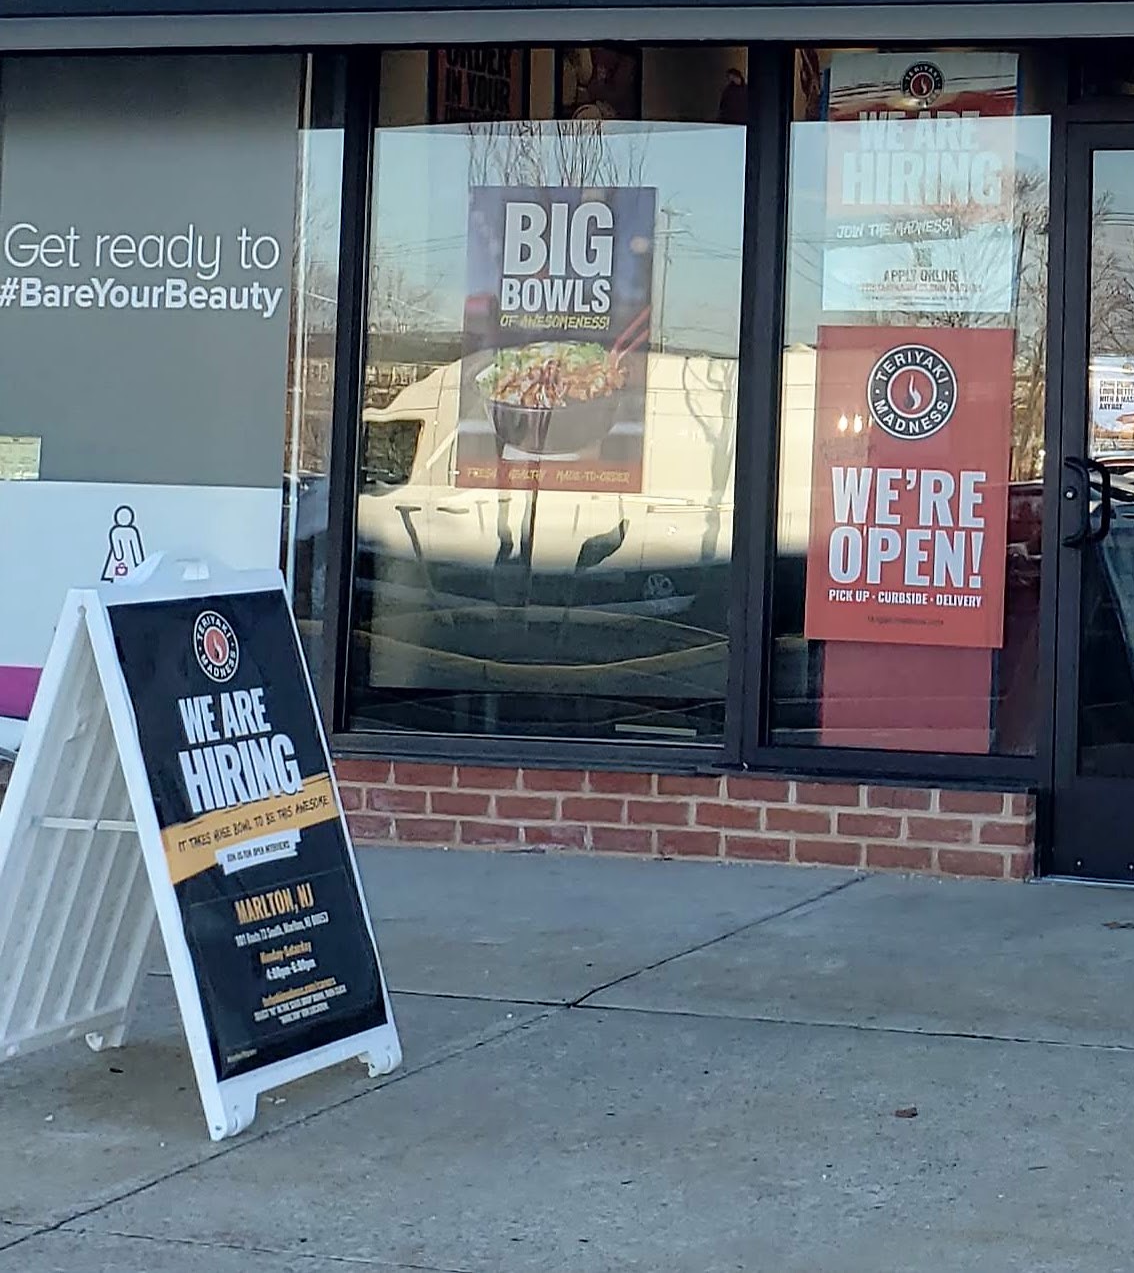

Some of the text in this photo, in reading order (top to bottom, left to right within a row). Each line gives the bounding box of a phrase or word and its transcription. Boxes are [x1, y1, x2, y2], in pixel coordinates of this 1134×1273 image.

[859, 110, 980, 150] WE ARE
[842, 150, 1002, 206] HIRING
[4, 222, 281, 280] Get ready to
[503, 202, 613, 277] BIG
[0, 276, 283, 318] #BareYourBeauty
[501, 278, 611, 313] BOWLS
[500, 314, 518, 327] OF
[875, 350, 949, 384] TERIYAKI
[874, 399, 949, 434] MADNESS
[831, 466, 987, 529] WE'RE
[828, 525, 985, 590] OPEN!
[828, 589, 983, 609] PICK UP CURBSIDE DELIVERY
[196, 614, 232, 641] TERIYAKI
[200, 650, 237, 679] MADNESS
[178, 687, 272, 745] WE ARE
[178, 733, 303, 815] HIRING
[234, 882, 315, 925] MARLTON, NJ
